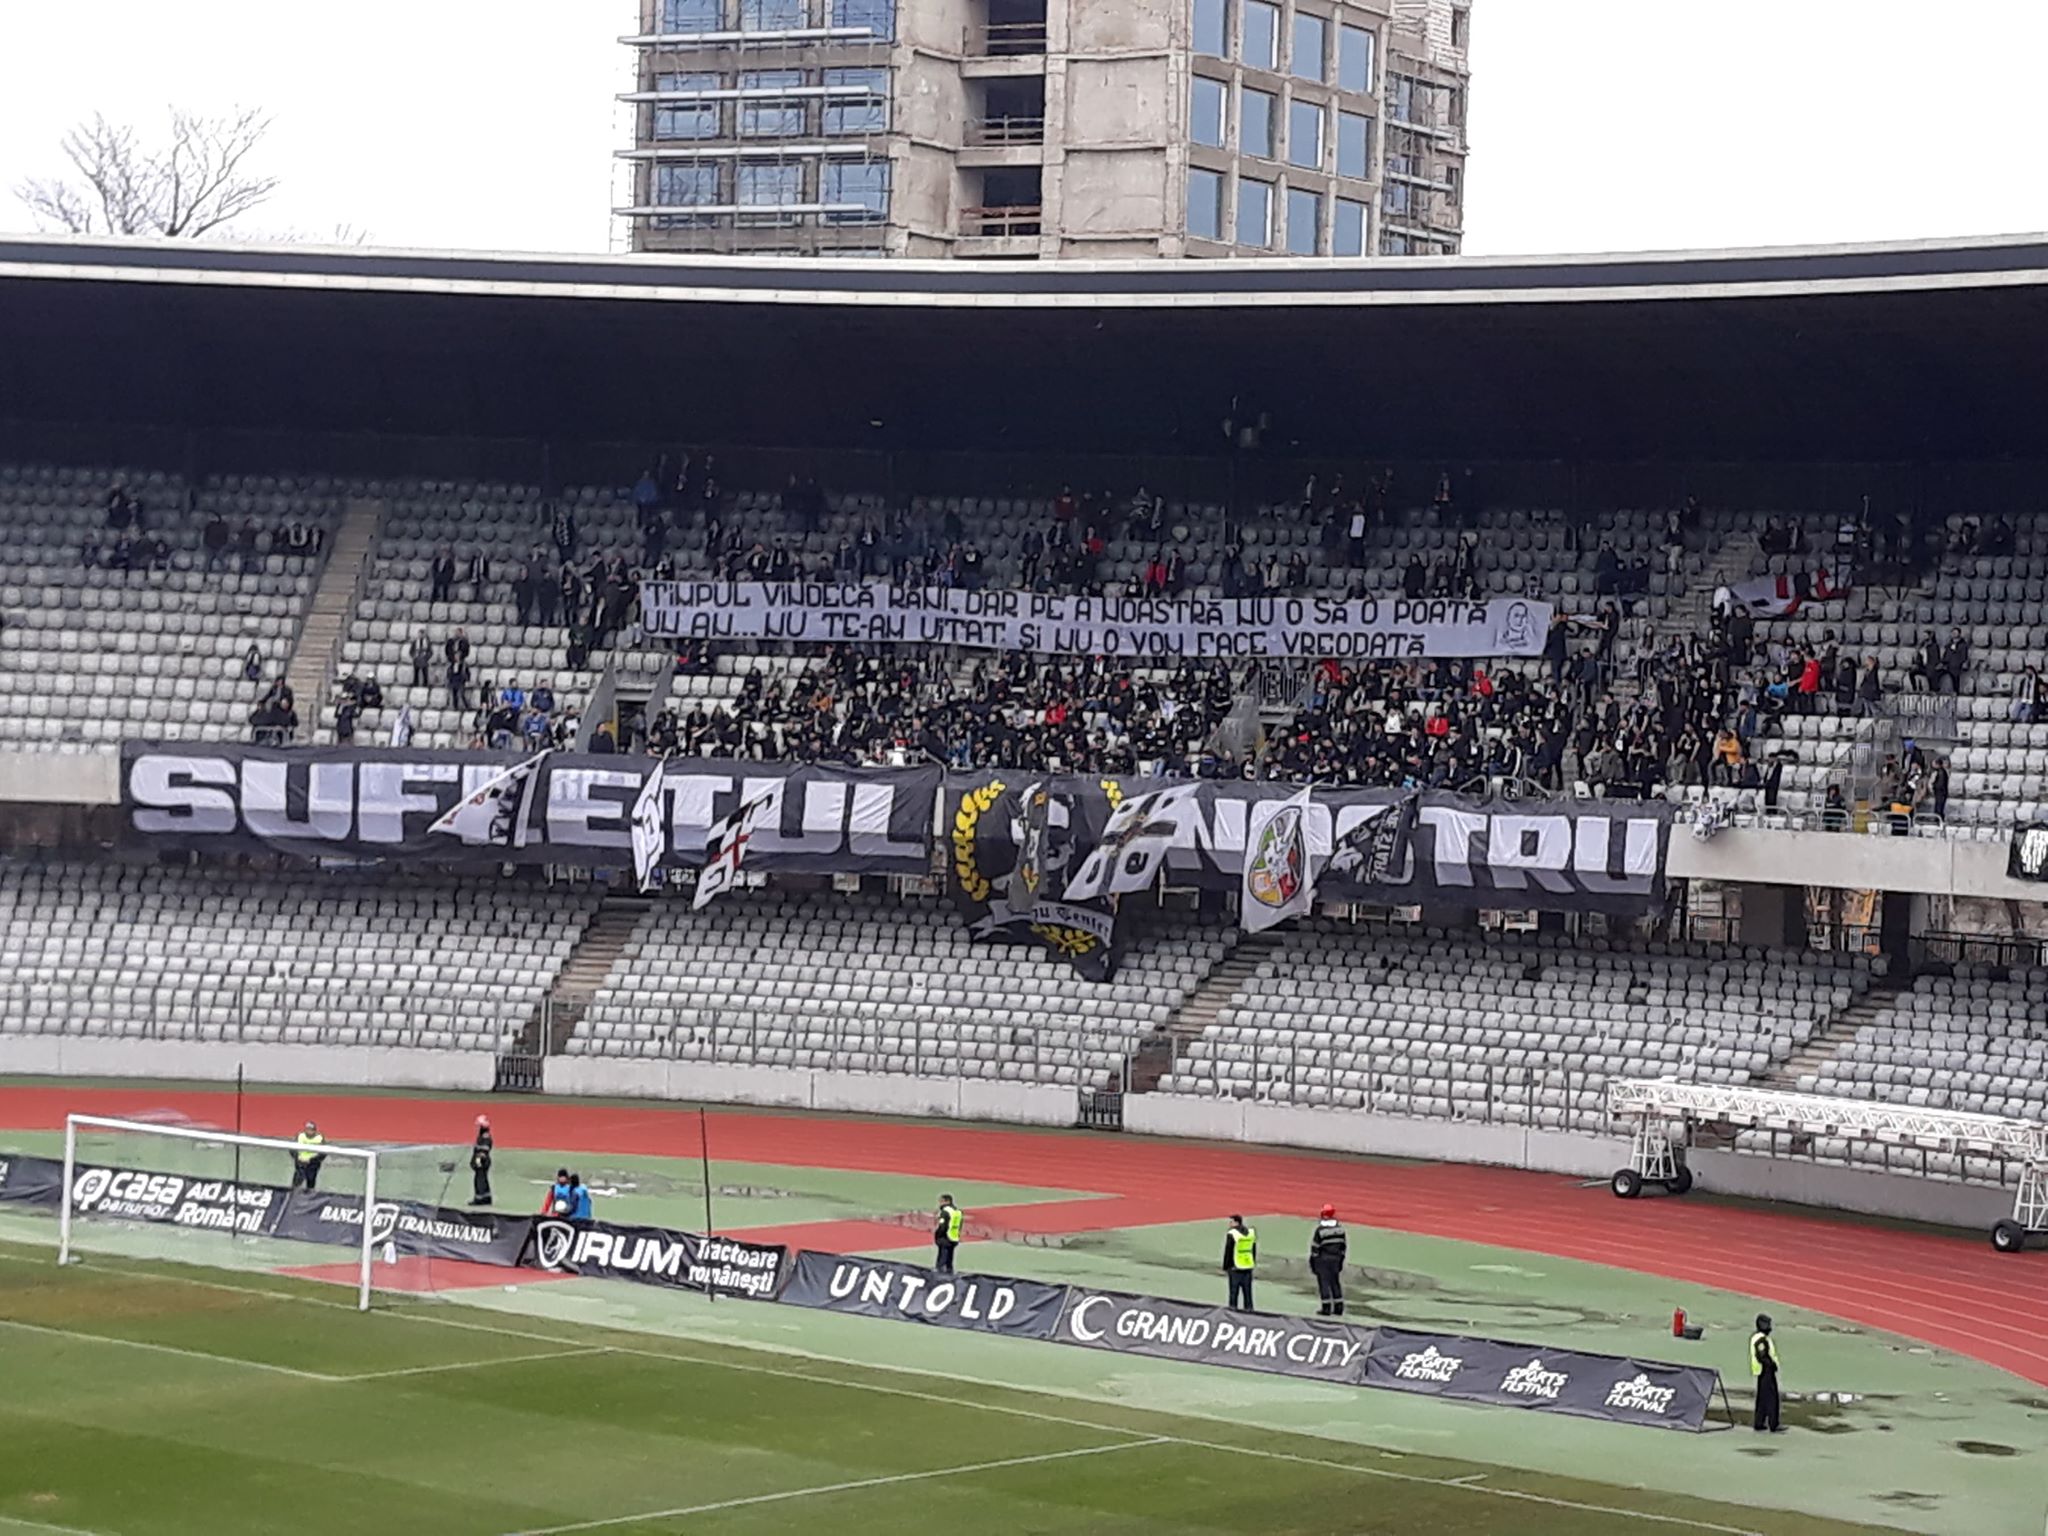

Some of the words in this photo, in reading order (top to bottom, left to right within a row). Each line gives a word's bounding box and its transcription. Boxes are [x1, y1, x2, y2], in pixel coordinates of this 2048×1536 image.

[966, 592, 1018, 618] DAR
[1031, 597, 1063, 620] PE
[1075, 598, 1092, 621] A
[1286, 599, 1303, 625] O
[1361, 599, 1379, 625] O
[764, 611, 807, 638] NU
[1130, 630, 1183, 657] VOM
[1197, 631, 1267, 656] FACE
[109, 1172, 184, 1204] casa
[320, 1206, 364, 1225] BANCA
[399, 1215, 491, 1243] TRANSILVANIA
[571, 1232, 684, 1276] IRUM
[697, 1240, 779, 1269] Tractoare
[829, 1264, 1015, 1320] UNTOLD
[1117, 1309, 1209, 1346] GRAND
[1211, 1322, 1285, 1357] PARK
[1287, 1334, 1361, 1366] CITY
[1405, 1352, 1463, 1371] SPORTS
[1507, 1367, 1568, 1387] SPORTS
[1613, 1380, 1675, 1401] SPORTS
